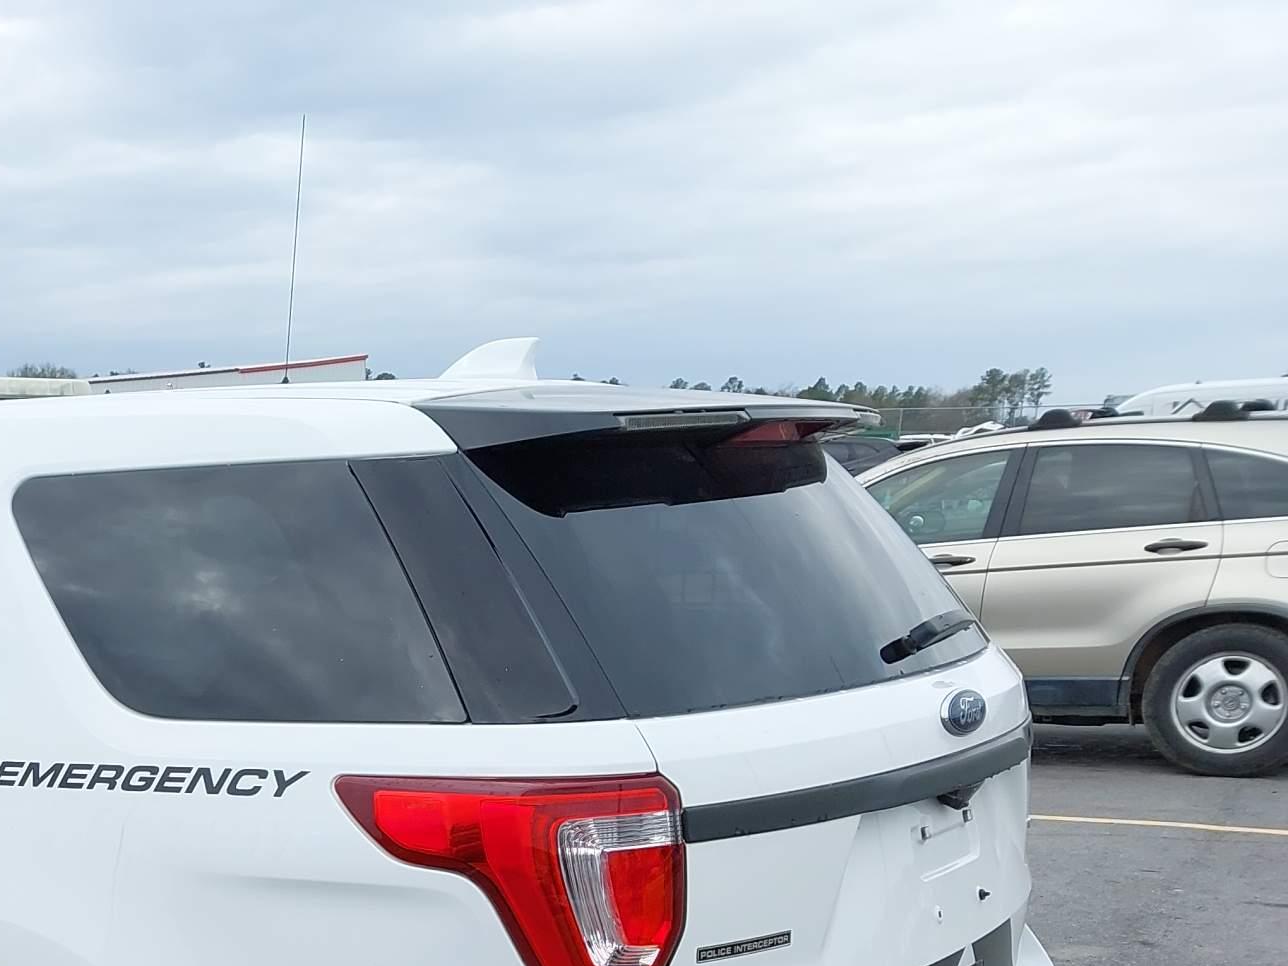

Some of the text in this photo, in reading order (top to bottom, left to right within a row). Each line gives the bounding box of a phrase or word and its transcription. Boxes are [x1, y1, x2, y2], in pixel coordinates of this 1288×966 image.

[959, 697, 982, 725] Ford
[700, 935, 789, 960] POLICE INTERCEPTOR
